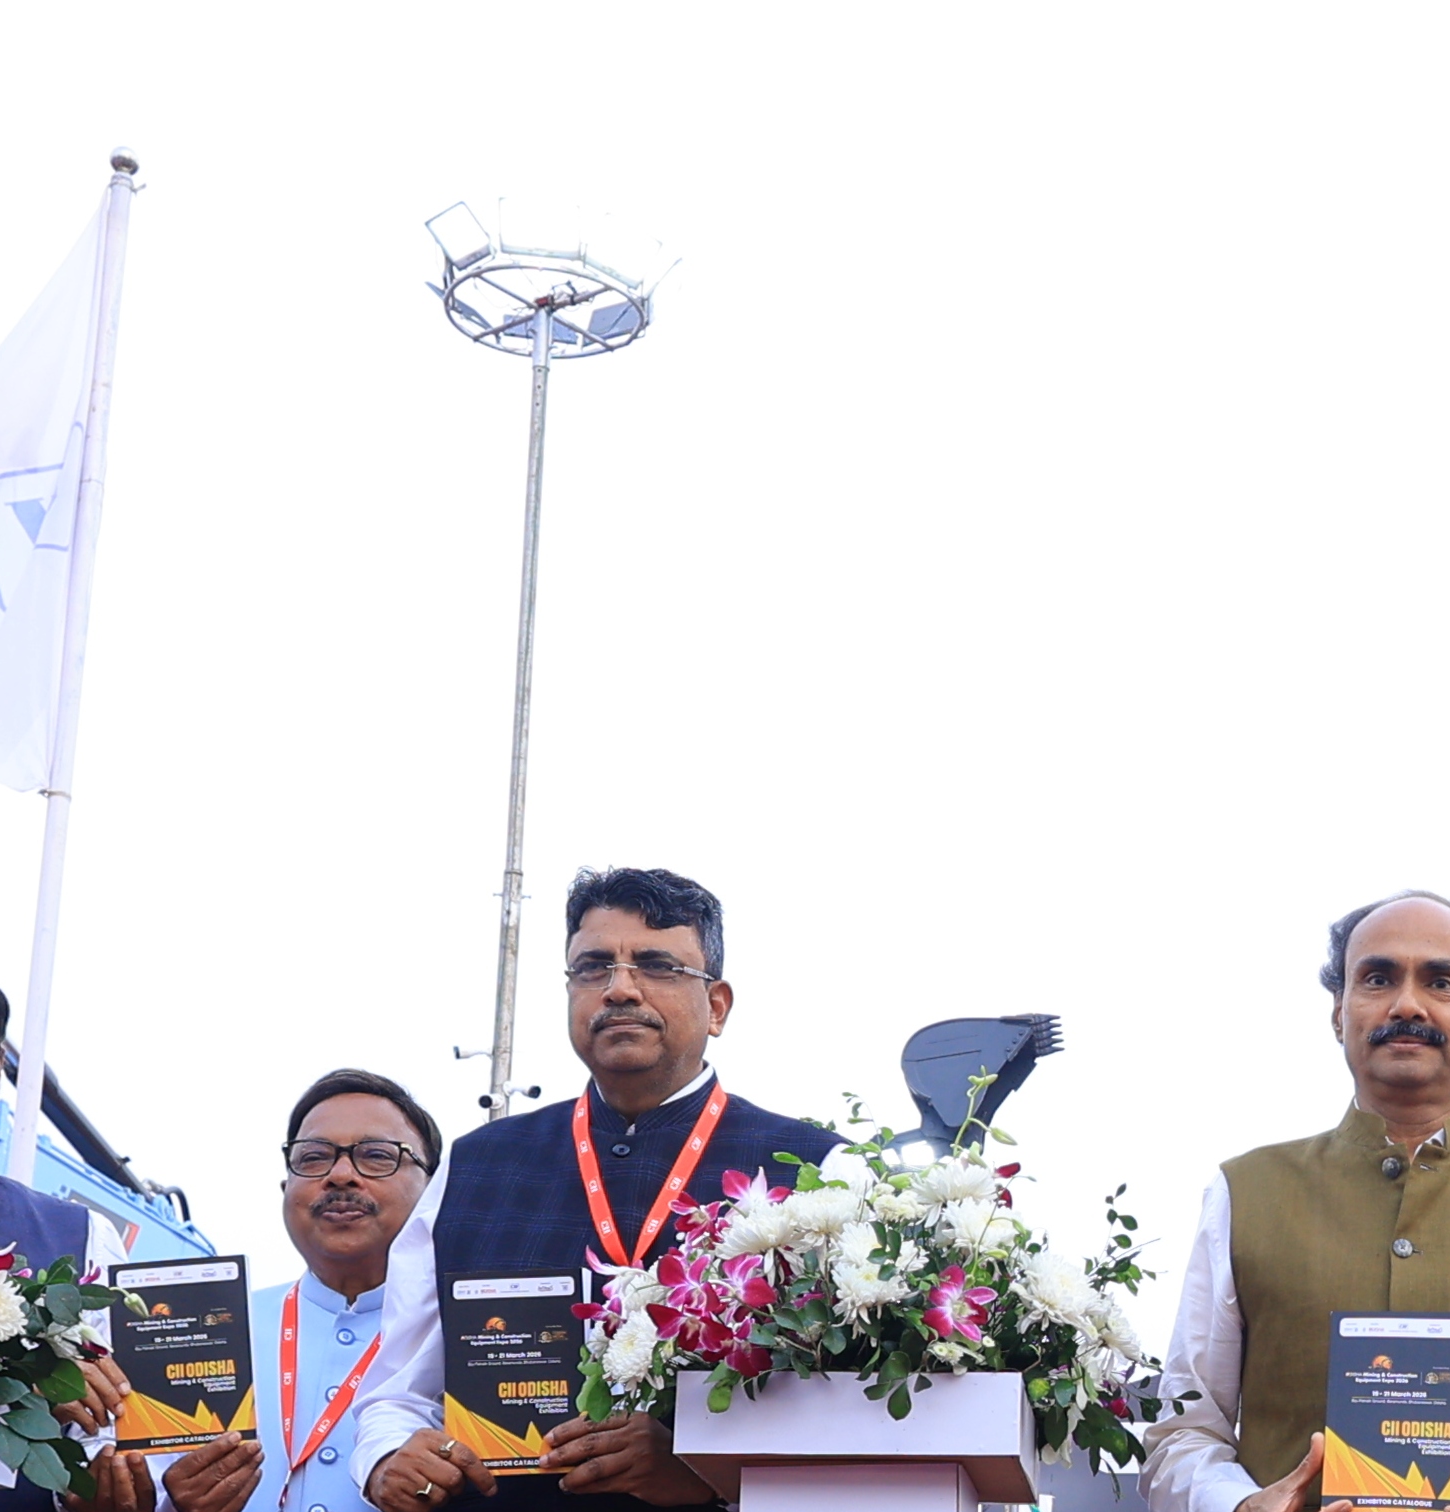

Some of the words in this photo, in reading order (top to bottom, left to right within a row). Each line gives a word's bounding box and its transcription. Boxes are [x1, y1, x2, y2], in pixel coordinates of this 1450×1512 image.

[579, 1140, 589, 1154] CII
[690, 1136, 702, 1151] CII
[588, 1180, 599, 1194] CII
[669, 1177, 682, 1190] CII
[601, 1220, 611, 1235] CII
[647, 1219, 660, 1233] CII
[284, 1328, 293, 1341] CII
[166, 1364, 184, 1379] CII
[186, 1359, 235, 1377] ODISHA
[283, 1372, 292, 1385] CII
[349, 1375, 363, 1391] CII
[498, 1382, 516, 1398] CII
[518, 1380, 568, 1398] ODISHA
[317, 1419, 331, 1434] CII
[1381, 1420, 1400, 1436] CII
[151, 1438, 184, 1446] EXHIBITOR
[1393, 1499, 1432, 1507] CATALOGUE
